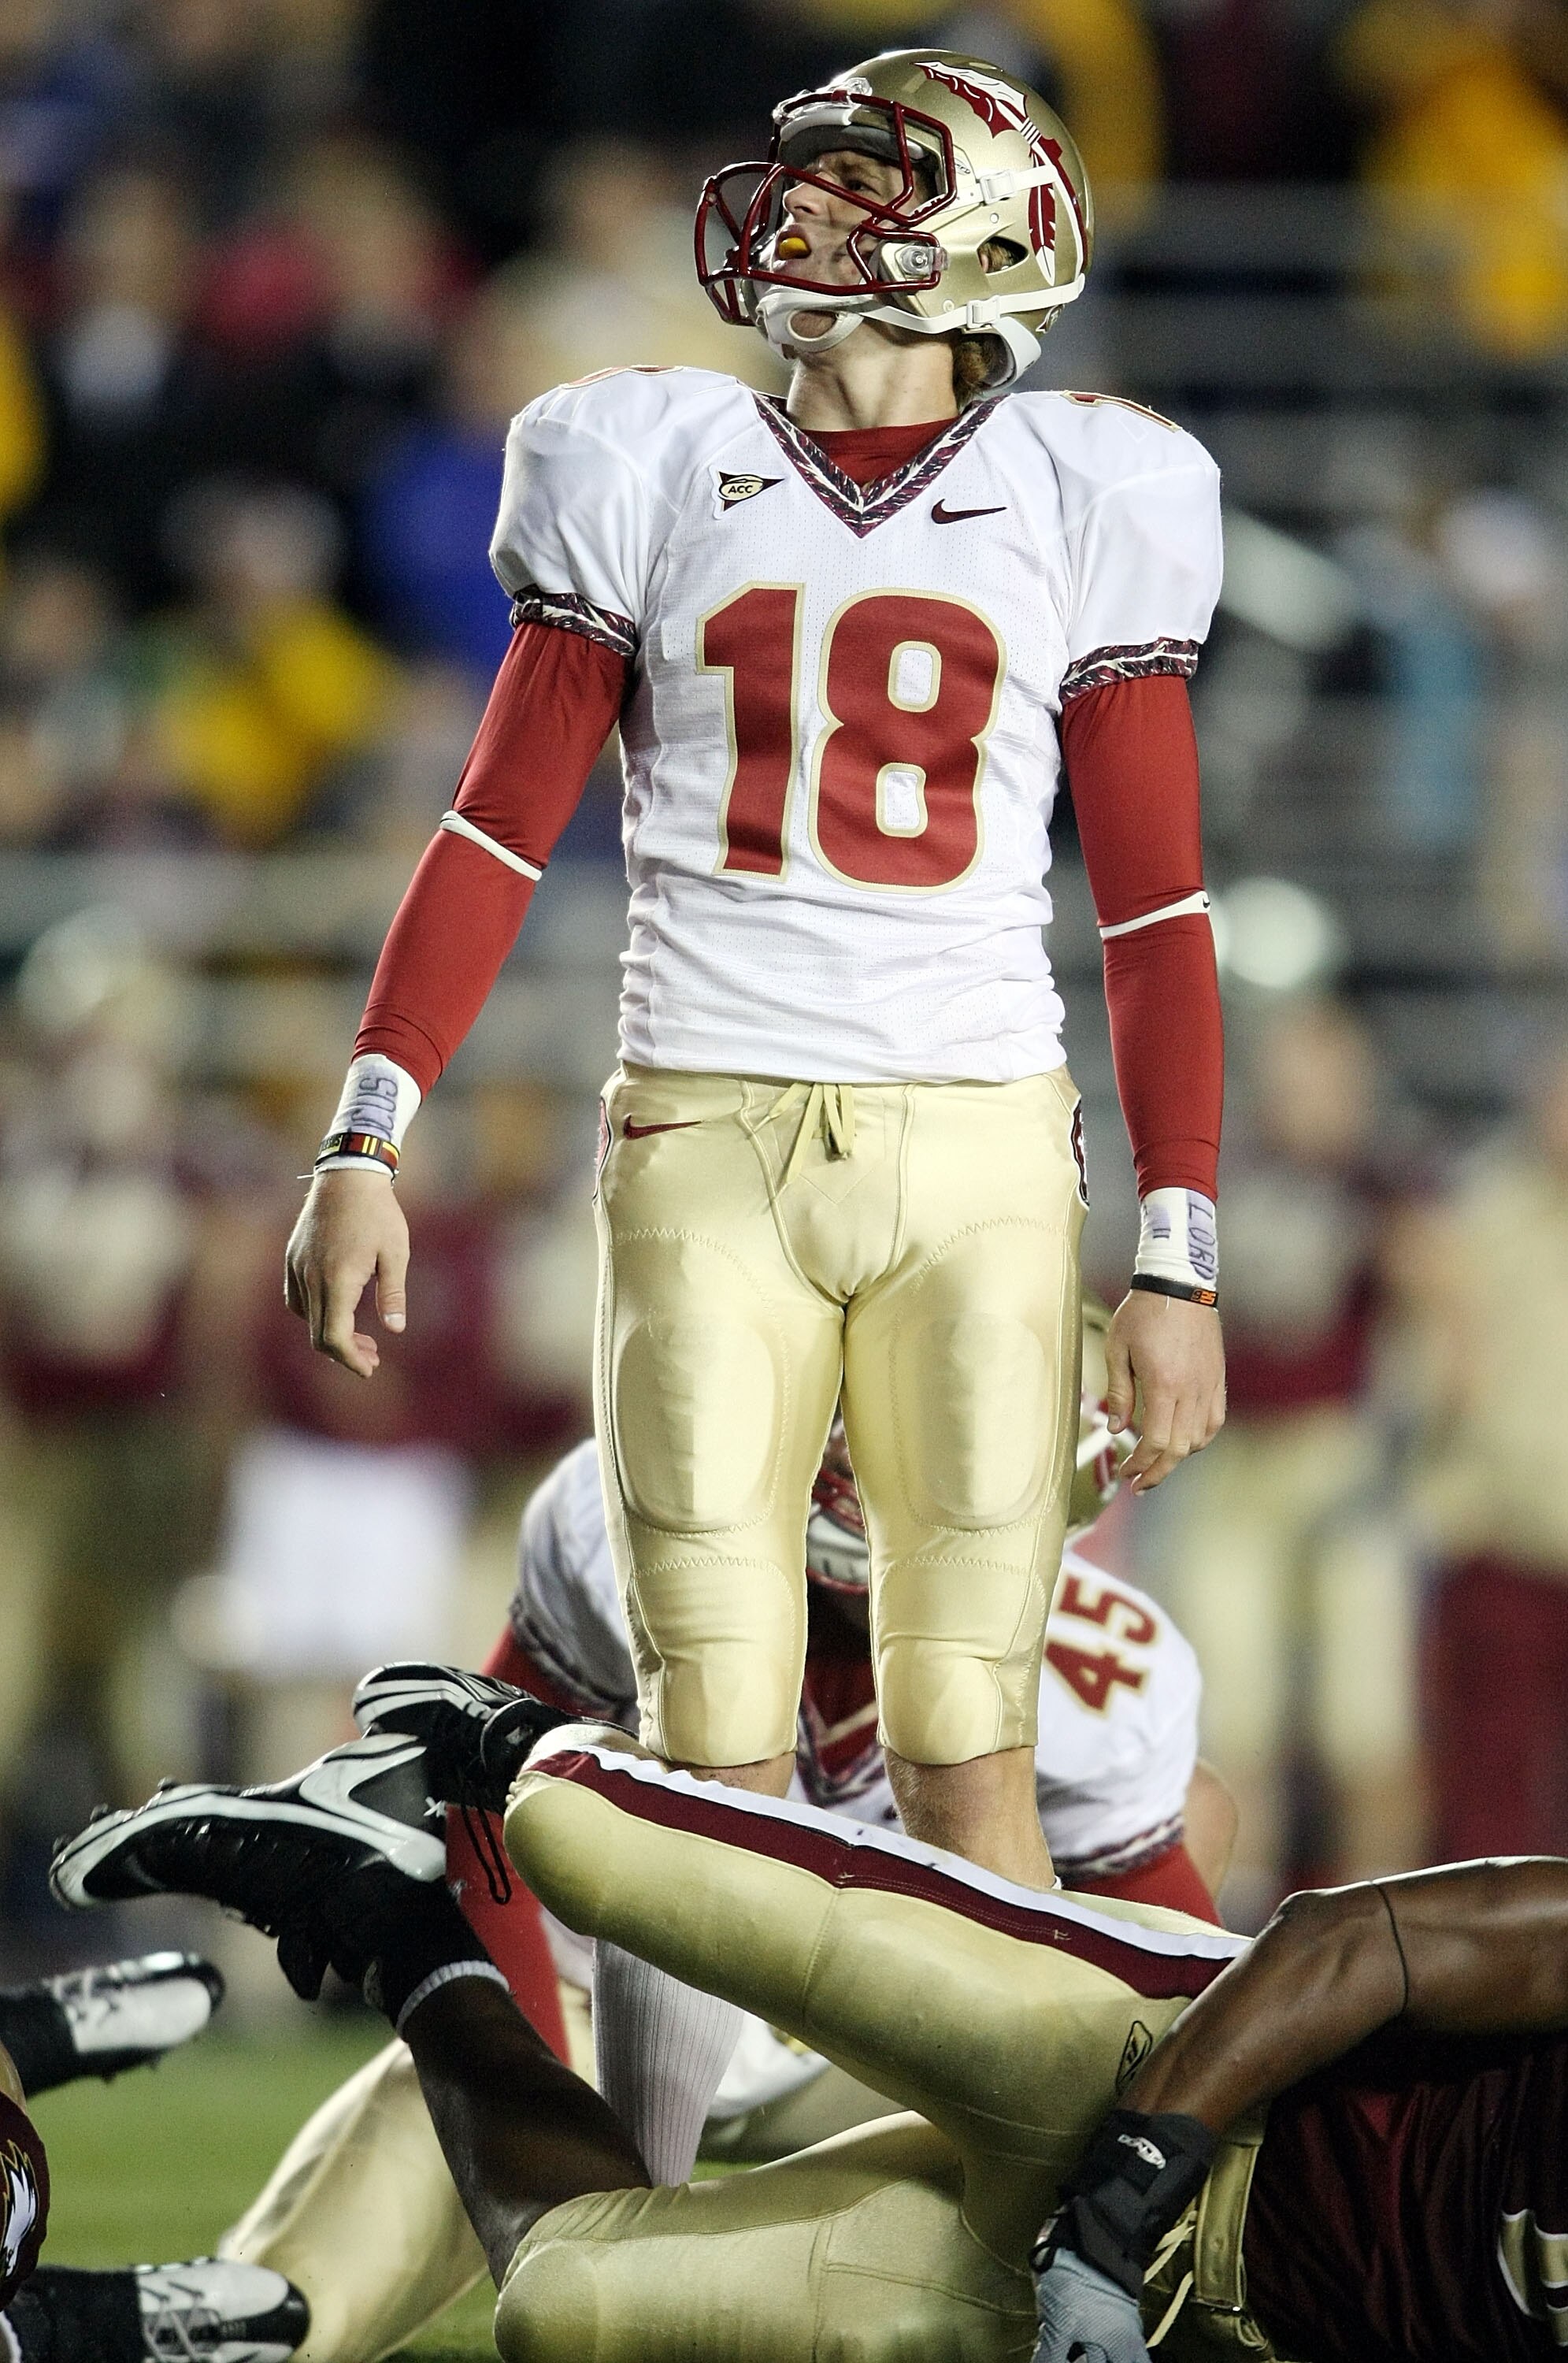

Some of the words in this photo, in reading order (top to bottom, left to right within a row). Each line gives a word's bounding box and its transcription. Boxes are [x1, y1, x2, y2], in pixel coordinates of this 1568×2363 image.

[727, 484, 754, 495] ACC
[695, 580, 1008, 896] 18
[1188, 1202, 1216, 1281] LORD
[1043, 1574, 1160, 1719] 45
